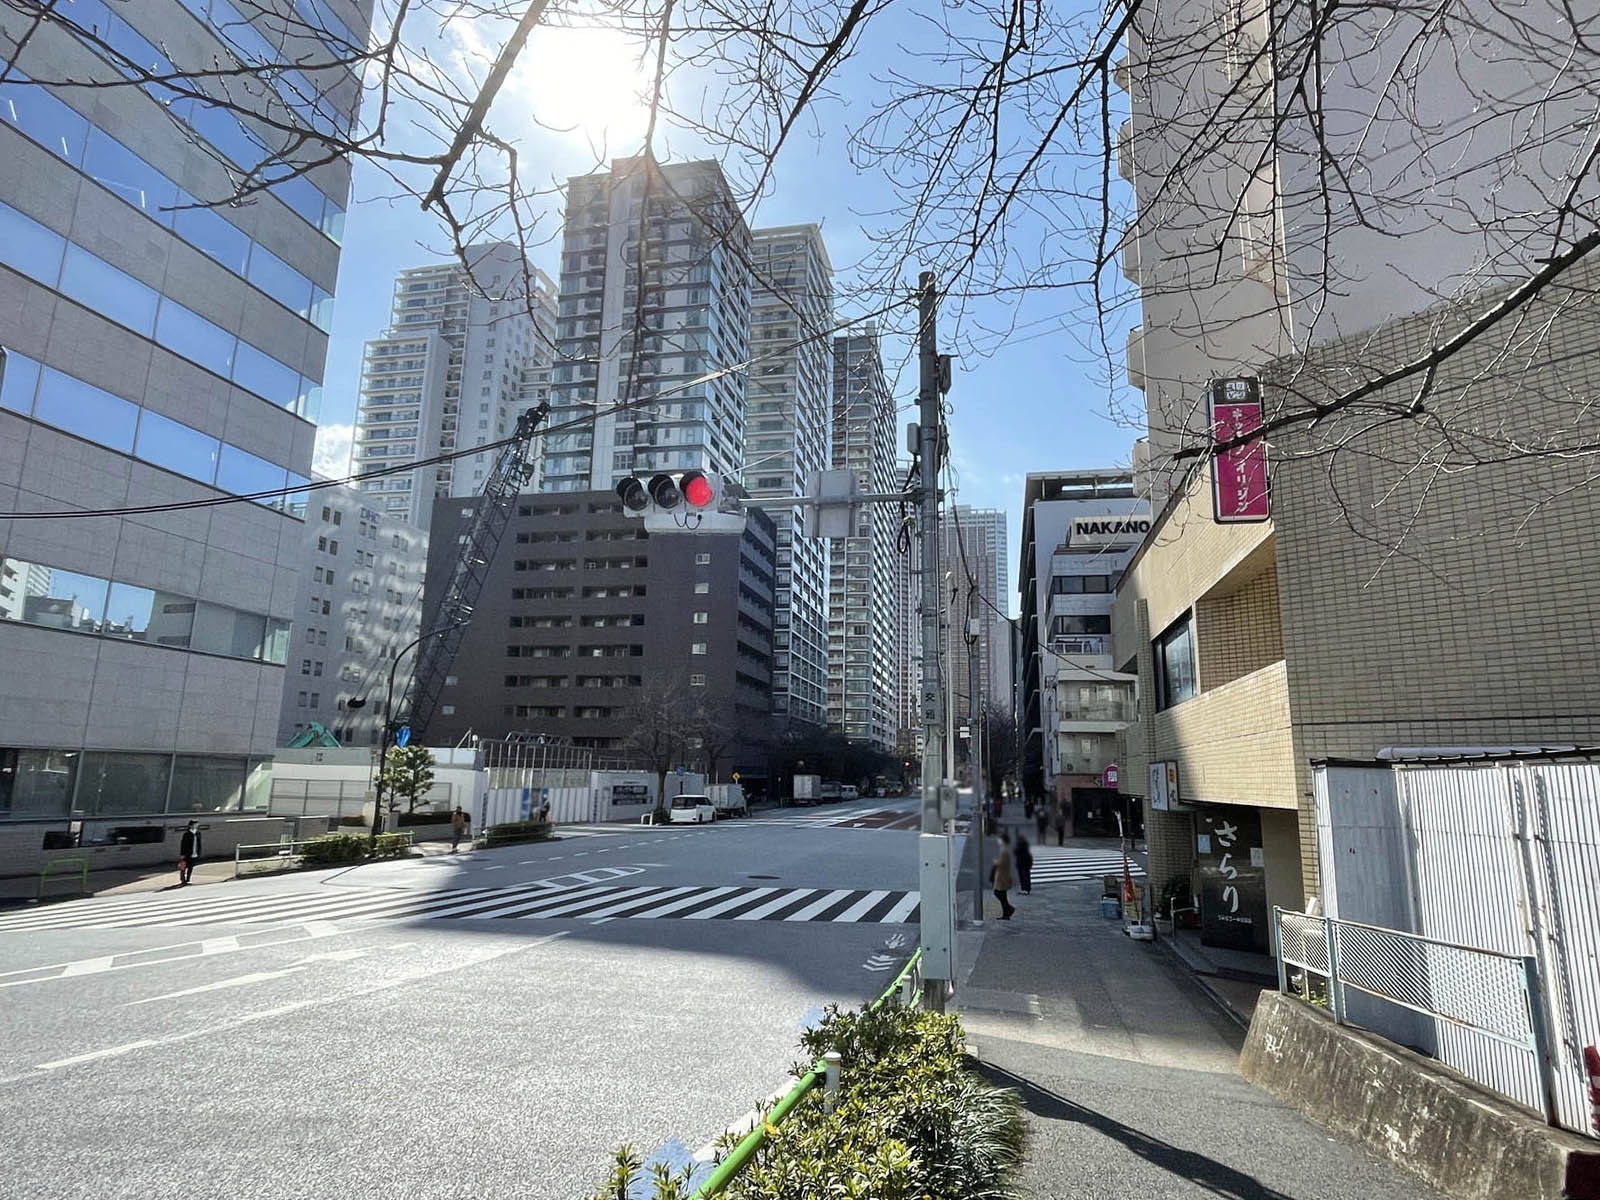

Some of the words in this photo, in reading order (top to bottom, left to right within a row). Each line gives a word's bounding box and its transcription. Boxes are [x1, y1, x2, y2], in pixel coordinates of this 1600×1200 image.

[1076, 520, 1150, 535] NAKANO
[1214, 820, 1239, 913] さらり
